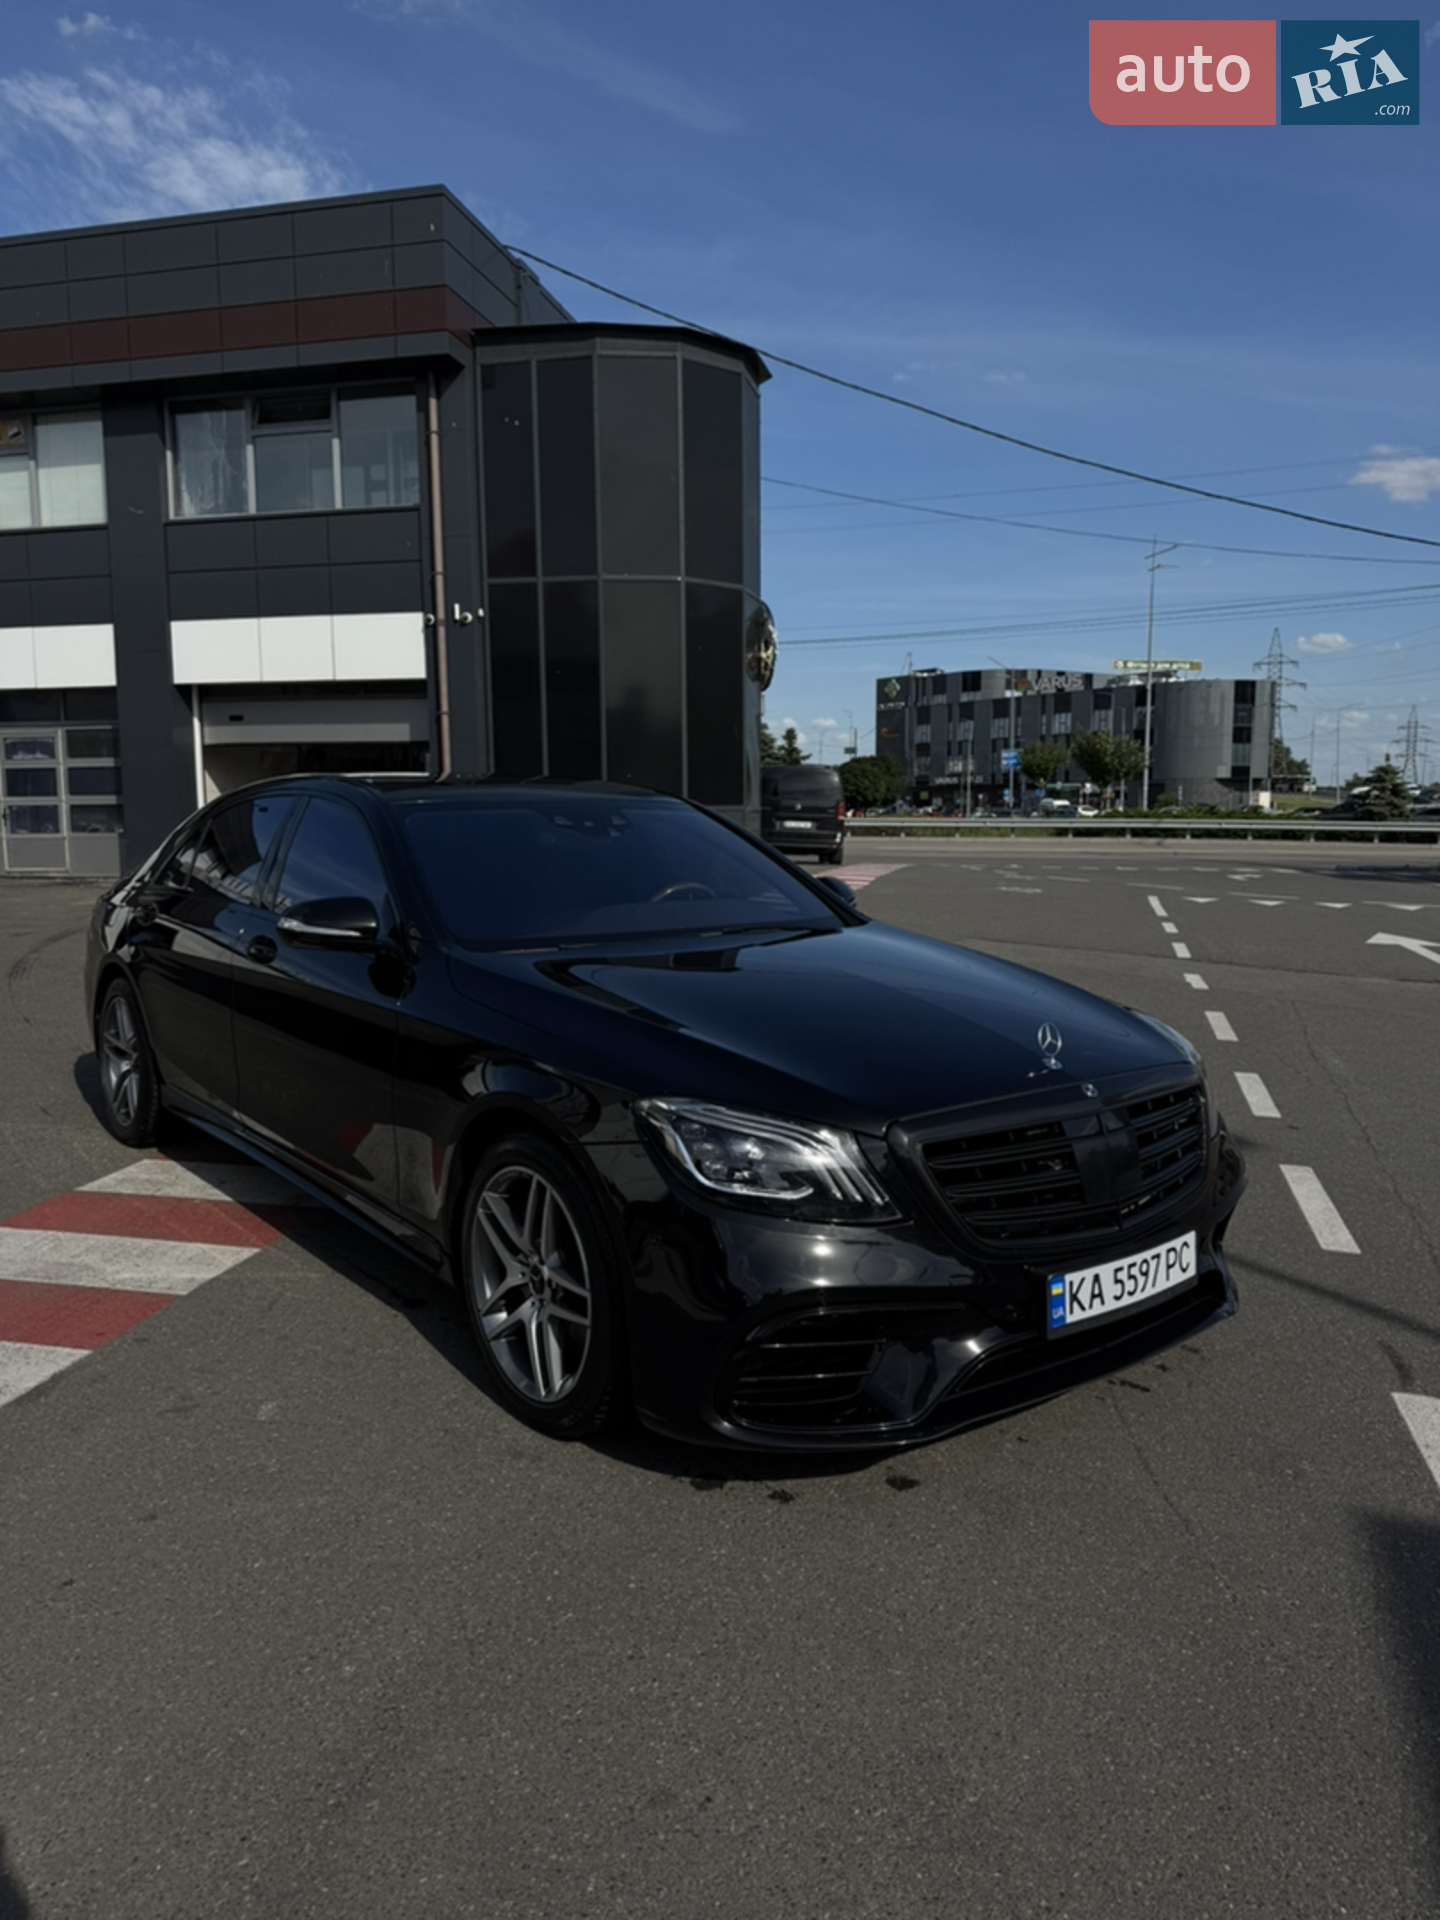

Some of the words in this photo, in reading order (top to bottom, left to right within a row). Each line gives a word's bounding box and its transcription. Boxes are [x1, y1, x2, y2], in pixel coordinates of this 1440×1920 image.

[1031, 674, 1083, 691] VARUS
[1069, 1273, 1105, 1315] KA
[1112, 1252, 1162, 1302] 5597
[1165, 1241, 1190, 1282] PC
